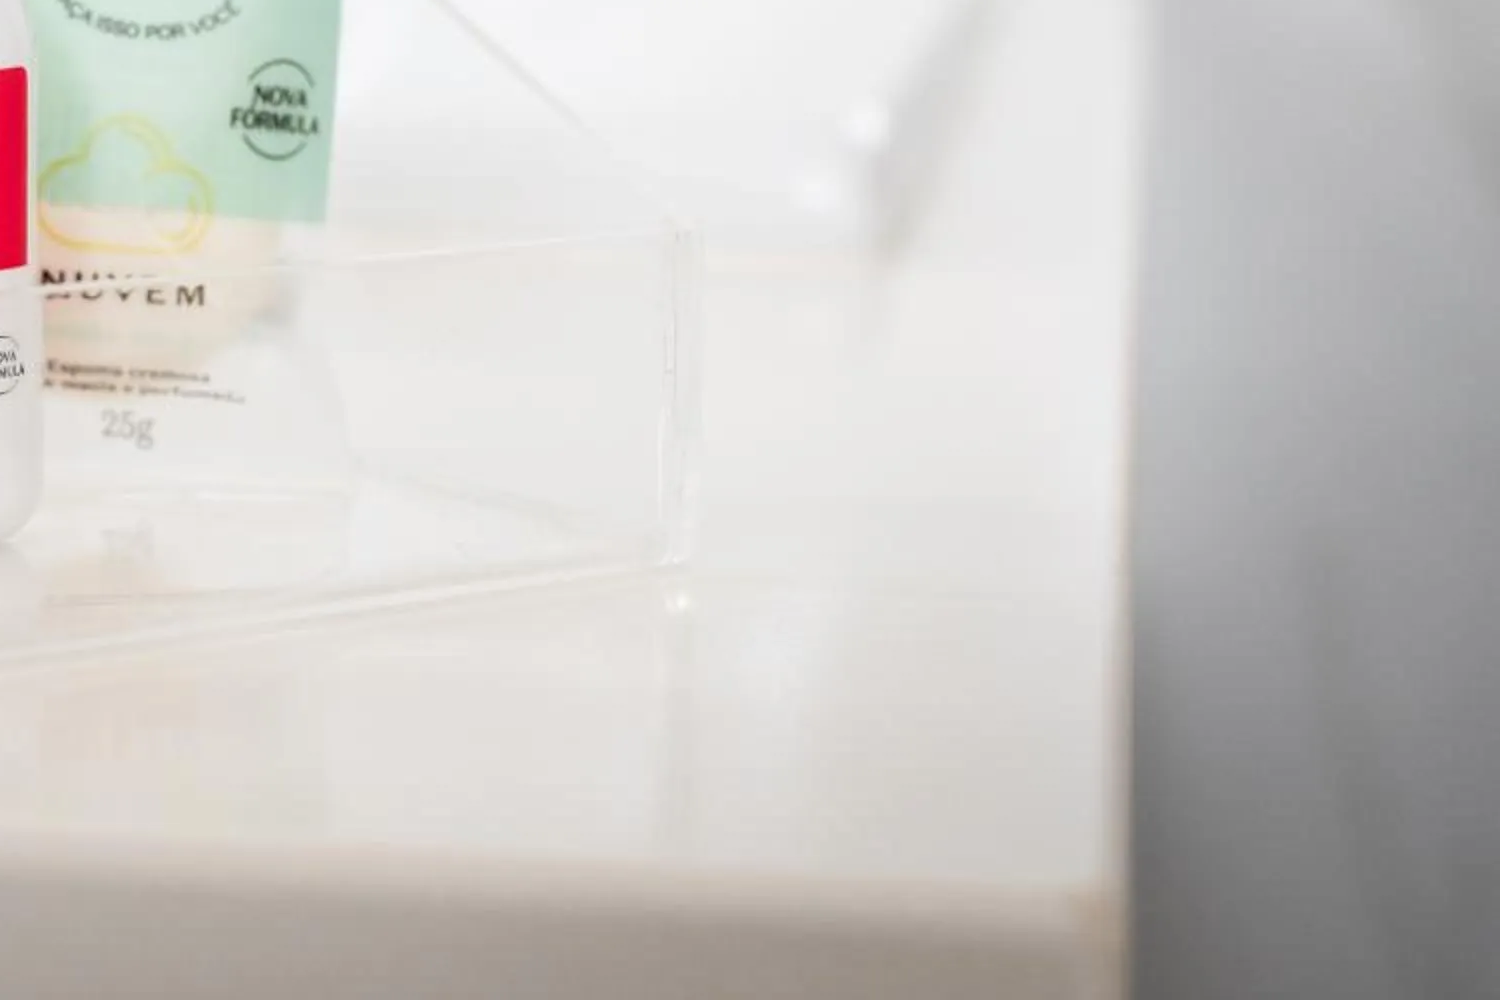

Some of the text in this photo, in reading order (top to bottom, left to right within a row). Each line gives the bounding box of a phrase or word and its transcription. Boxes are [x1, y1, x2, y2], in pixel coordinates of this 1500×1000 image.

[145, 22, 188, 41] POR
[252, 84, 308, 108] NOVA
[100, 407, 156, 450] 25g
